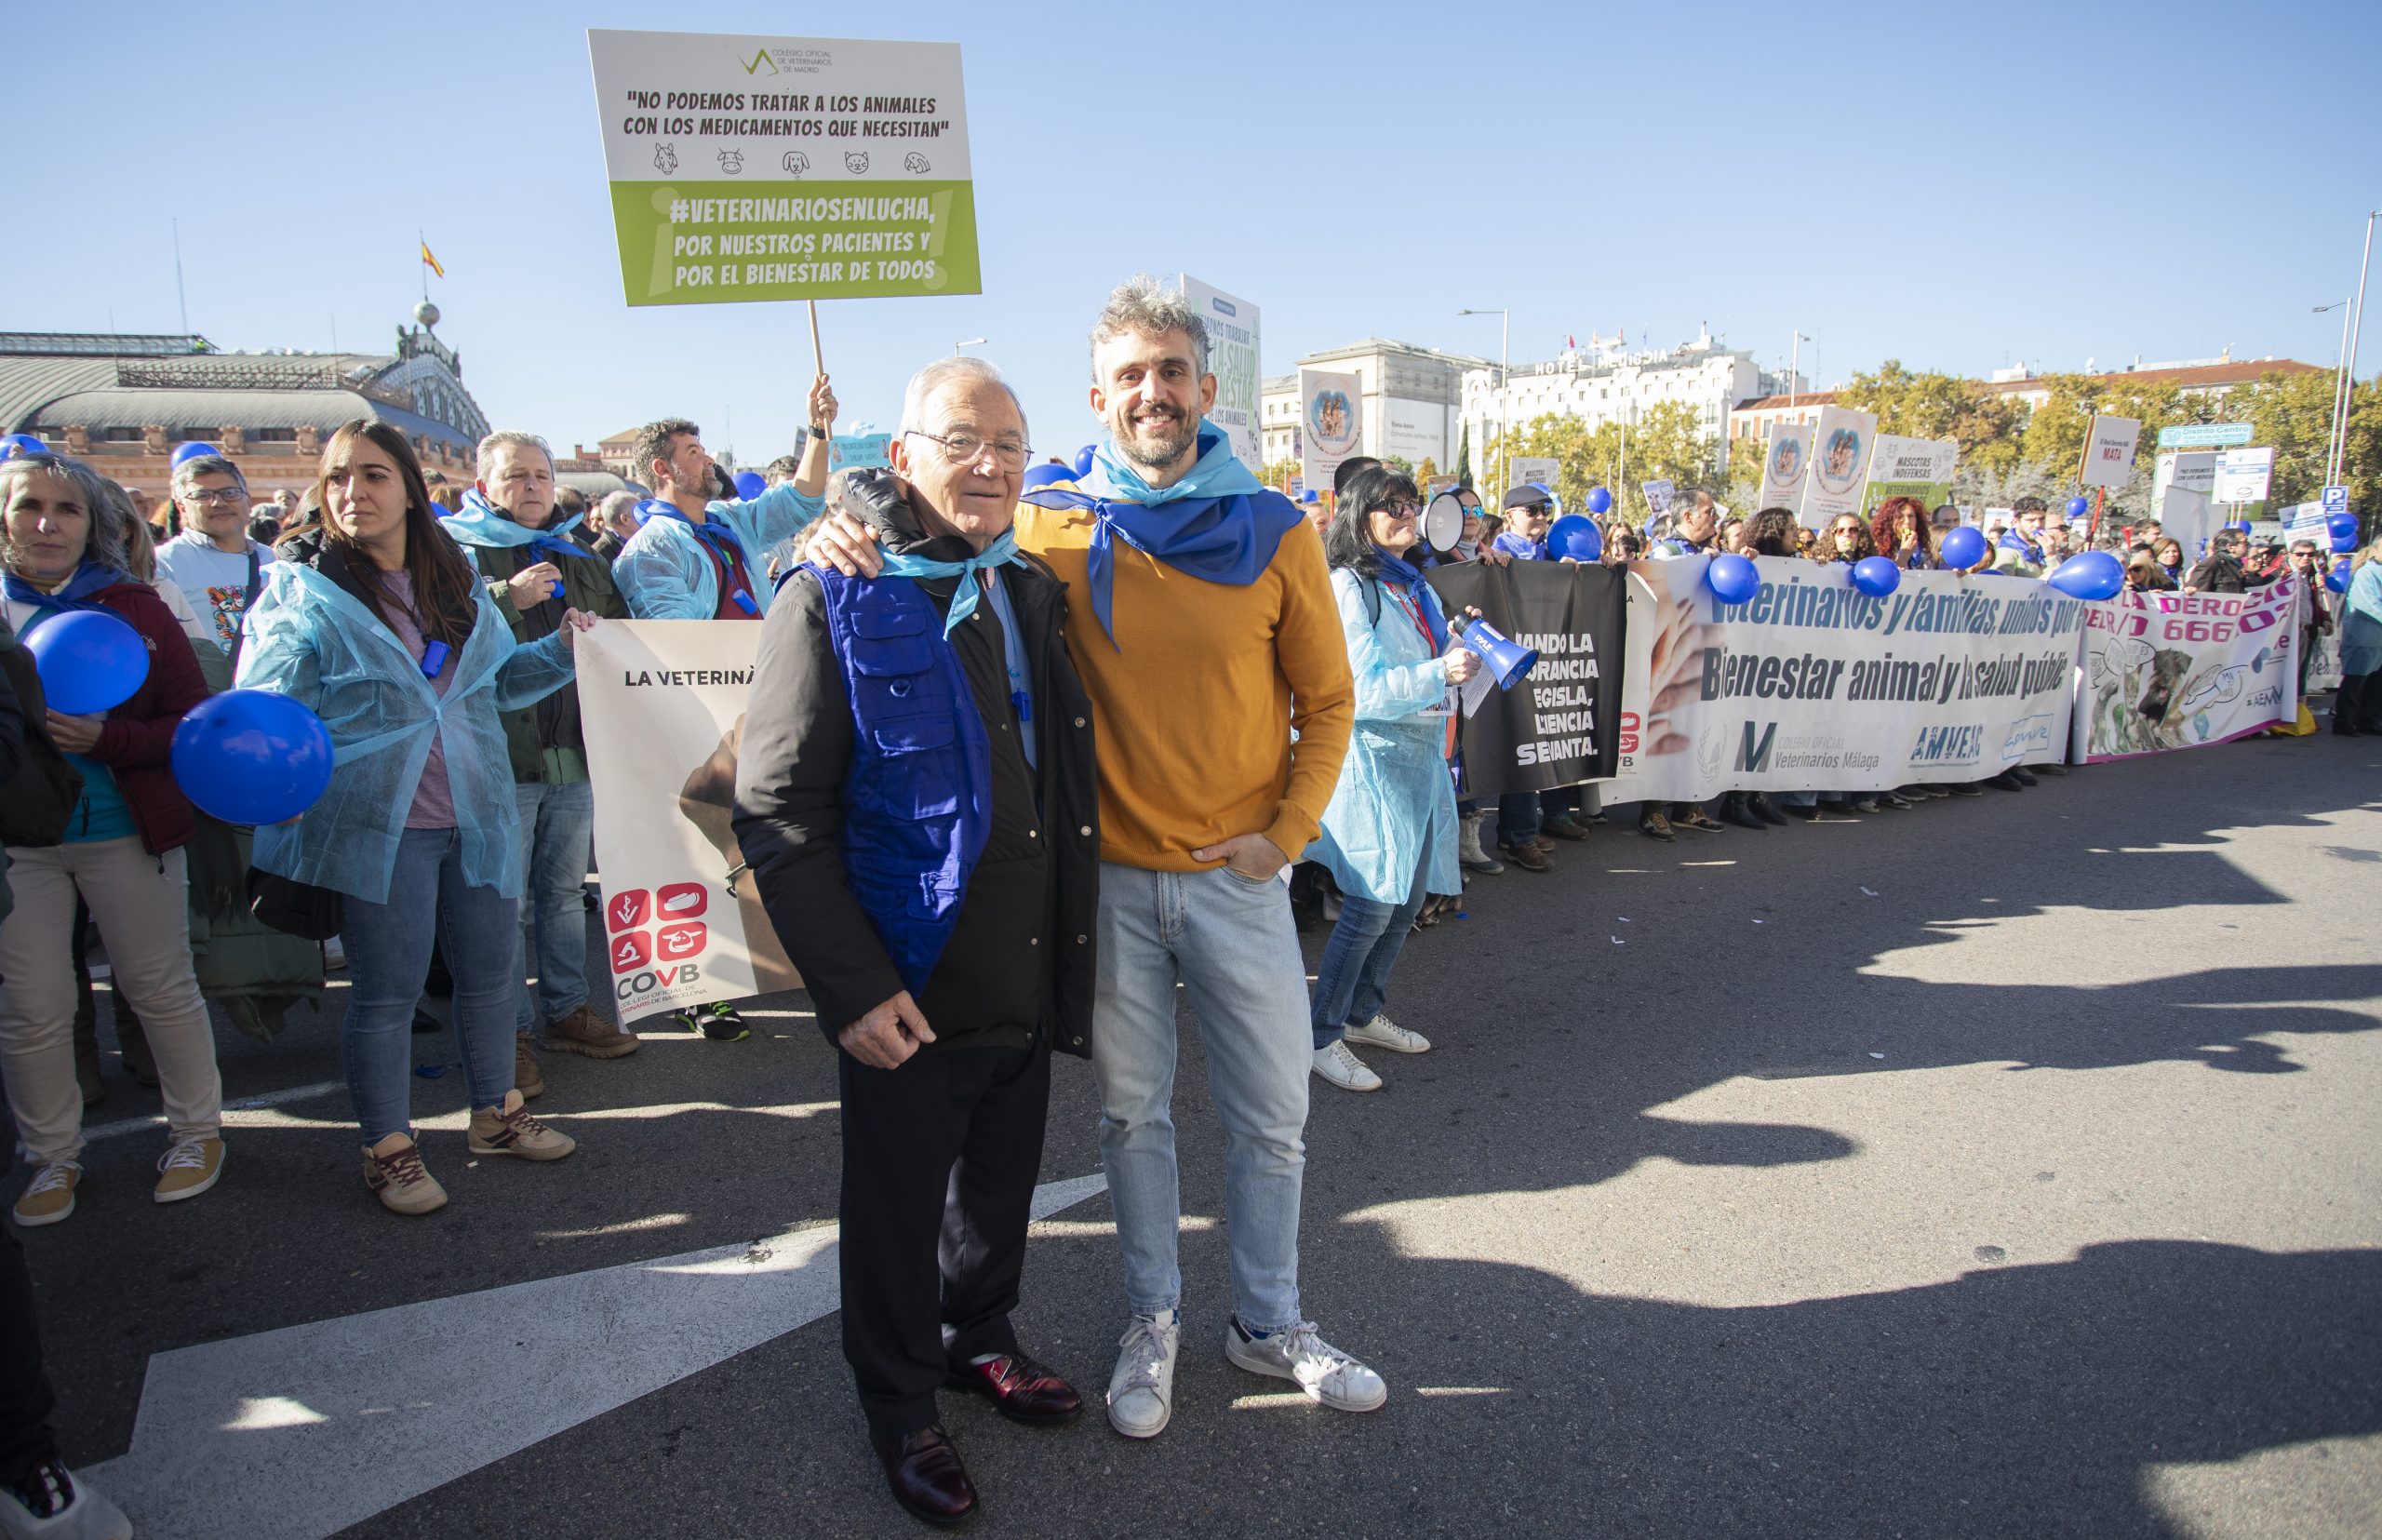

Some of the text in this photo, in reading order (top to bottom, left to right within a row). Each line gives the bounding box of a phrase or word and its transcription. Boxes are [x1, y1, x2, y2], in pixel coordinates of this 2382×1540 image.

[771, 48, 803, 57] COLEGIO
[788, 58, 832, 66] VETERINARIOS
[627, 90, 937, 114] "NO PODEMOS TRATAR A LOS ANIMALES
[623, 116, 949, 138] CON LOS MEDICAMENTOS QUE NECESITAN"
[670, 196, 935, 223] #VETERINARIOSENLUCHA,
[675, 232, 931, 257] POR NUESTROS PACIENTES Y
[676, 260, 935, 287] POR EL BIENESTAR DE TODOS
[1225, 323, 1251, 346] TRABAJAR
[1212, 338, 1256, 381] LA SALUD
[1534, 355, 1587, 376] HOTEL
[1215, 408, 1224, 424] LOS
[1224, 409, 1248, 426] ANIMALES
[1896, 457, 1933, 467] MASCOTAS
[2102, 448, 2122, 462] MATA
[1892, 468, 1933, 479] INDEFENSAS
[2325, 489, 2344, 504] P
[1883, 593, 1911, 636] y
[1998, 592, 2053, 636] unidos
[2050, 599, 2078, 638] por
[1475, 634, 1493, 651] PYLE
[1569, 633, 1594, 653] LA
[625, 671, 652, 687] LA
[1701, 647, 1846, 702] Bienestar
[1848, 652, 1945, 703] animal
[1937, 662, 1960, 704] y
[1958, 654, 1973, 701] la
[1974, 653, 2024, 699] salud
[2020, 650, 2068, 700] públic
[1778, 736, 1846, 750] COLEGIO OFICIAL
[1775, 751, 1880, 772] Veterinarios Málaga
[617, 963, 701, 1000] COVB
[650, 986, 682, 998] OFICIAL
[662, 988, 707, 1002] BARCELONA
